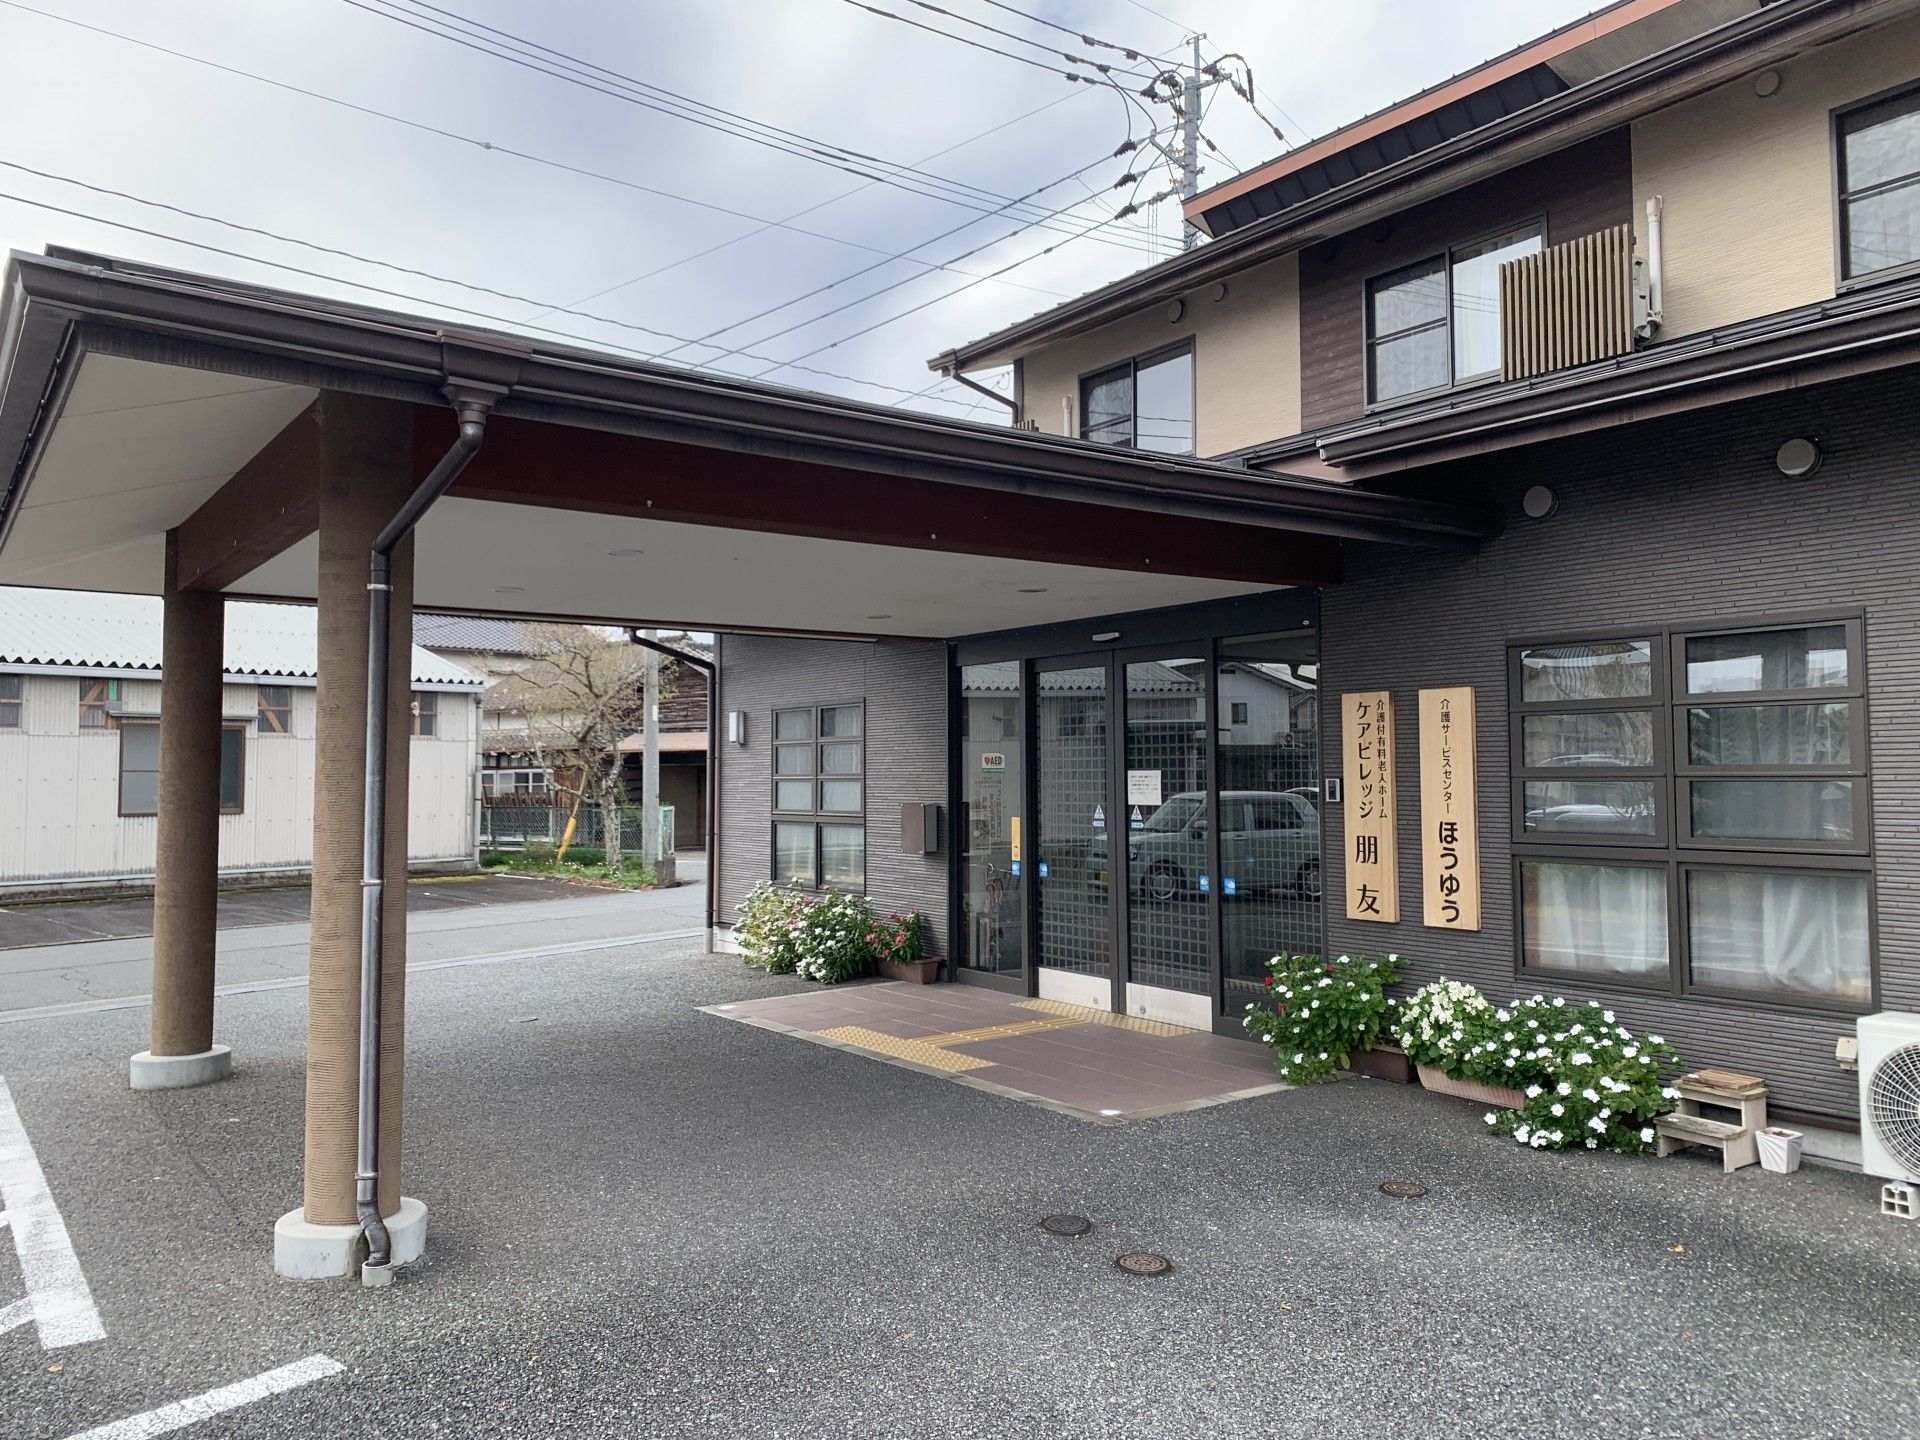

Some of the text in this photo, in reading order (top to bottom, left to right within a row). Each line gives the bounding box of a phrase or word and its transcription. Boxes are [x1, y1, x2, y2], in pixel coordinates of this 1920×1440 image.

[990, 756, 1003, 765] AED
[1356, 701, 1380, 915] ケアビレッジ 朋友
[1376, 699, 1388, 819] 介護付有料老人ホーム
[1438, 698, 1460, 923] 介護サービスセンター ほうゆう
